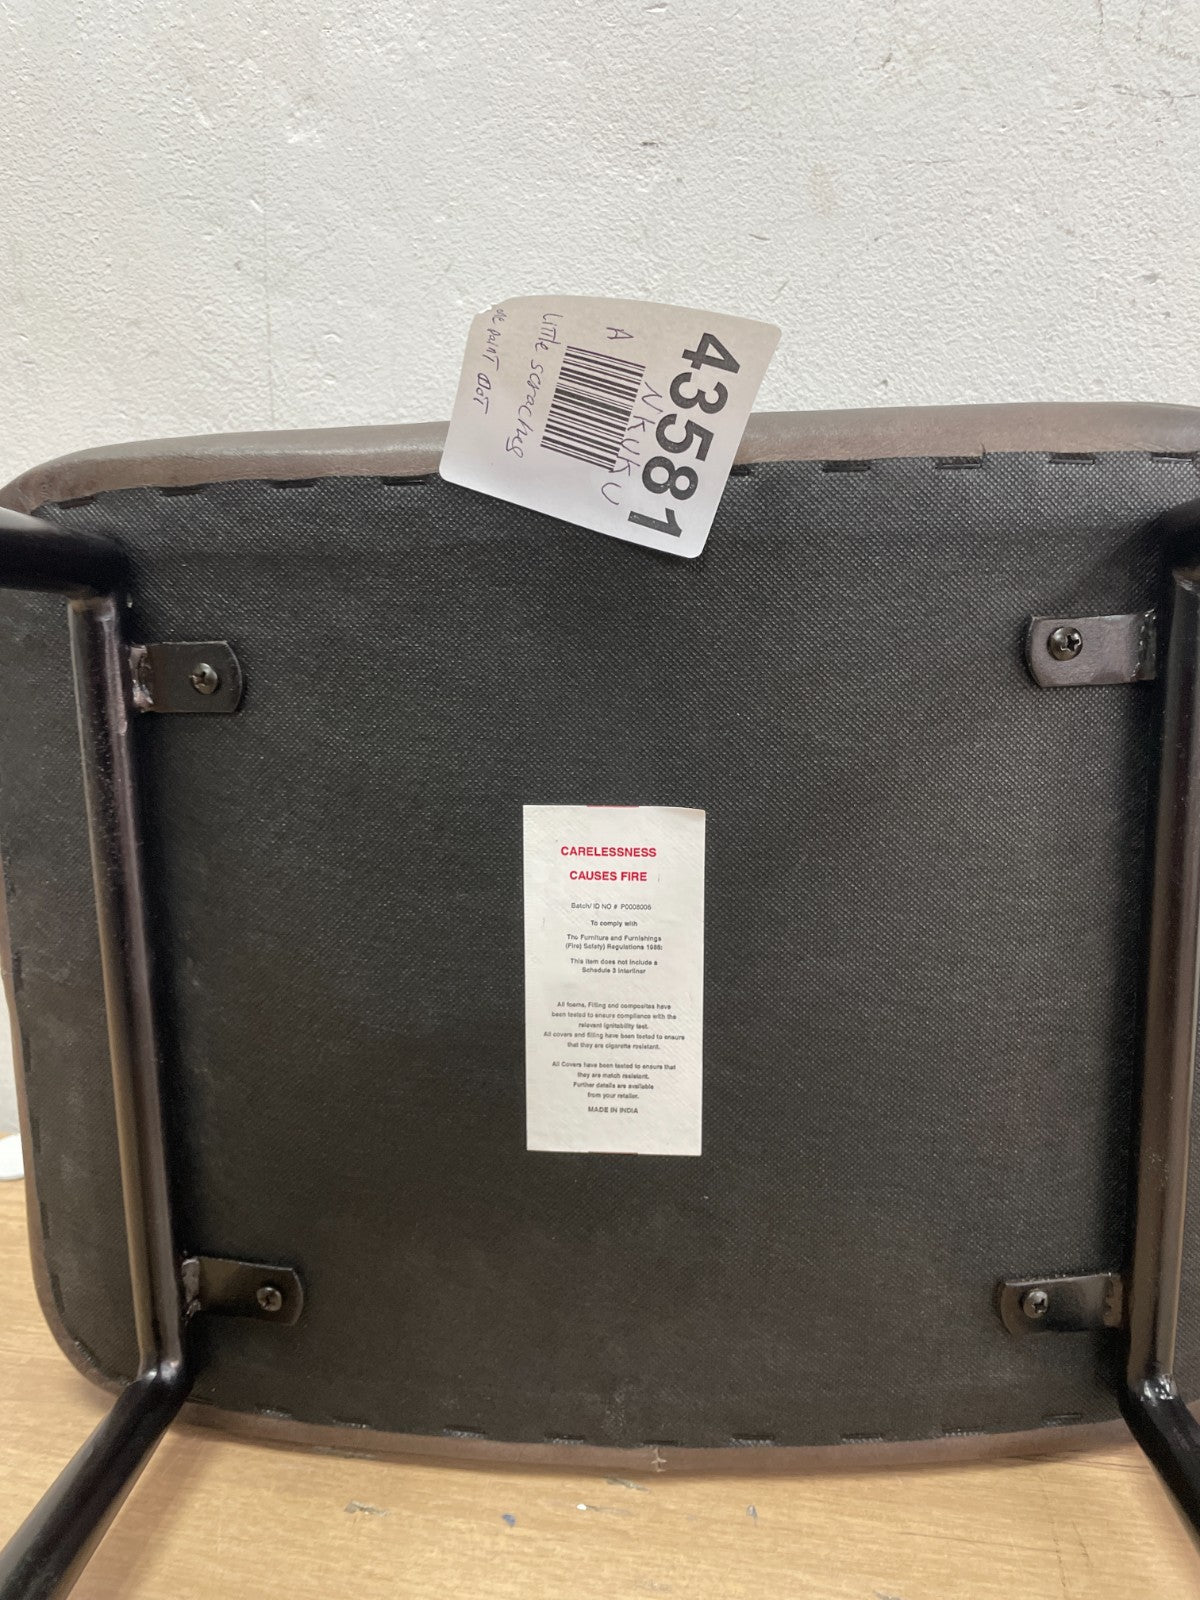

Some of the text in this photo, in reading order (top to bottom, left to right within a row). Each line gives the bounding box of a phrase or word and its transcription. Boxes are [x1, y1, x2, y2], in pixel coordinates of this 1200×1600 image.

[606, 327, 634, 339] A
[628, 332, 741, 539] 43581
[601, 381, 663, 505] NKUKU
[561, 846, 657, 857] CARELESSNESS
[569, 870, 647, 881] CAUSES FIRE
